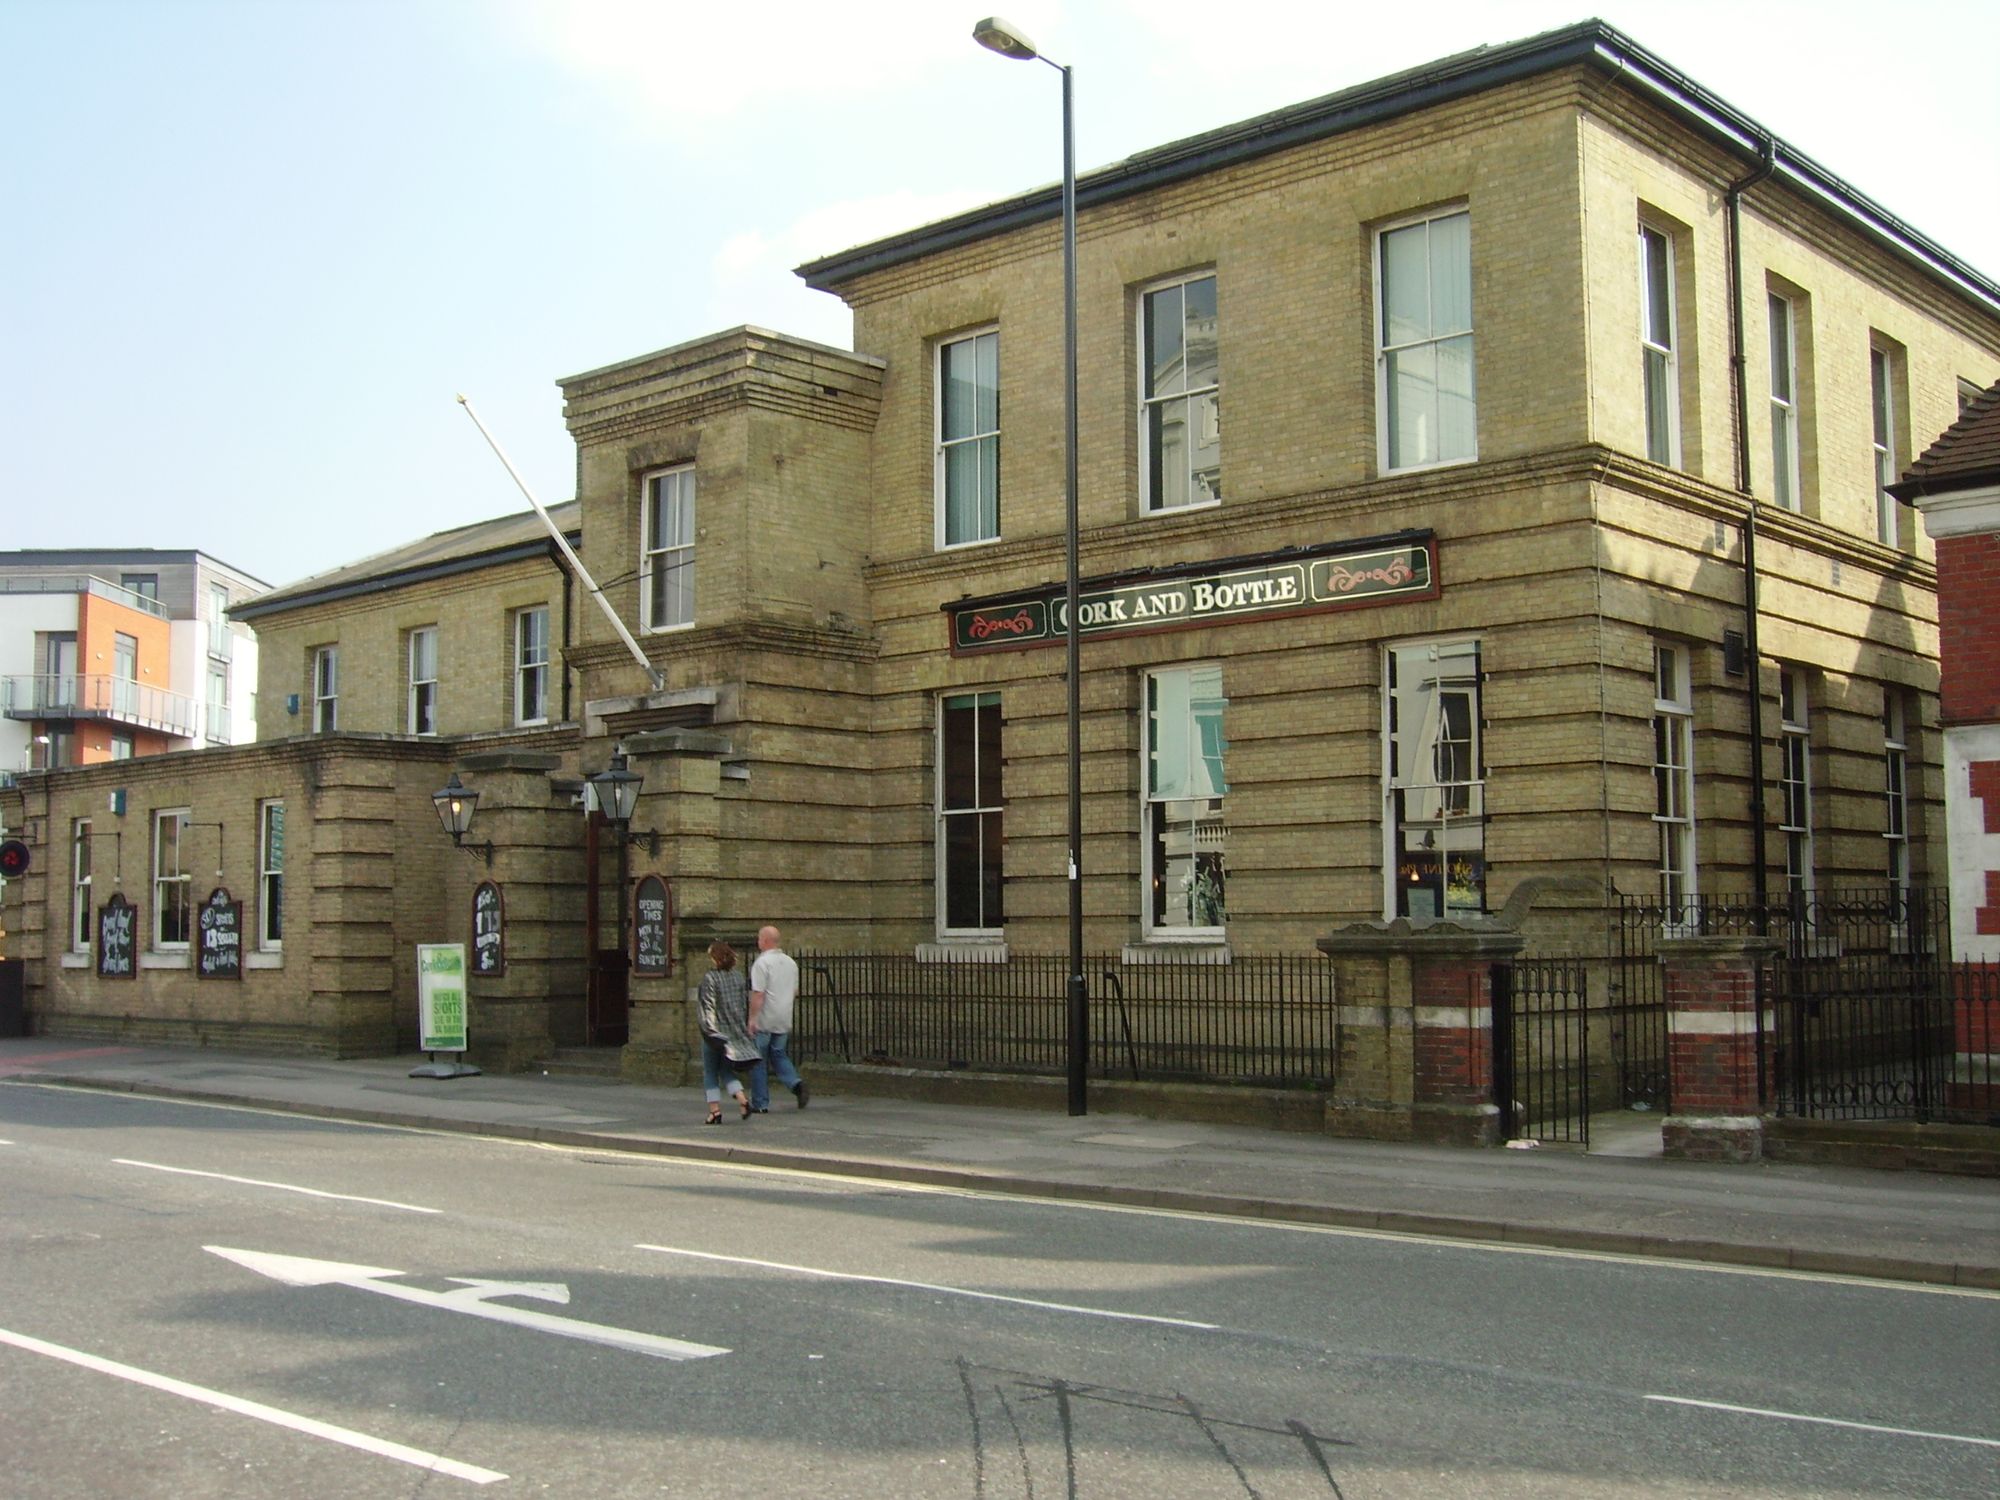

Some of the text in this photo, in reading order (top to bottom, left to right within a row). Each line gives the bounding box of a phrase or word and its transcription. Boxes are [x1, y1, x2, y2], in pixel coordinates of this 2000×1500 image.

[1132, 591, 1188, 618] AND
[1192, 575, 1298, 612] BOTTLE
[639, 899, 664, 910] OPENING
[643, 910, 662, 921] TIMES
